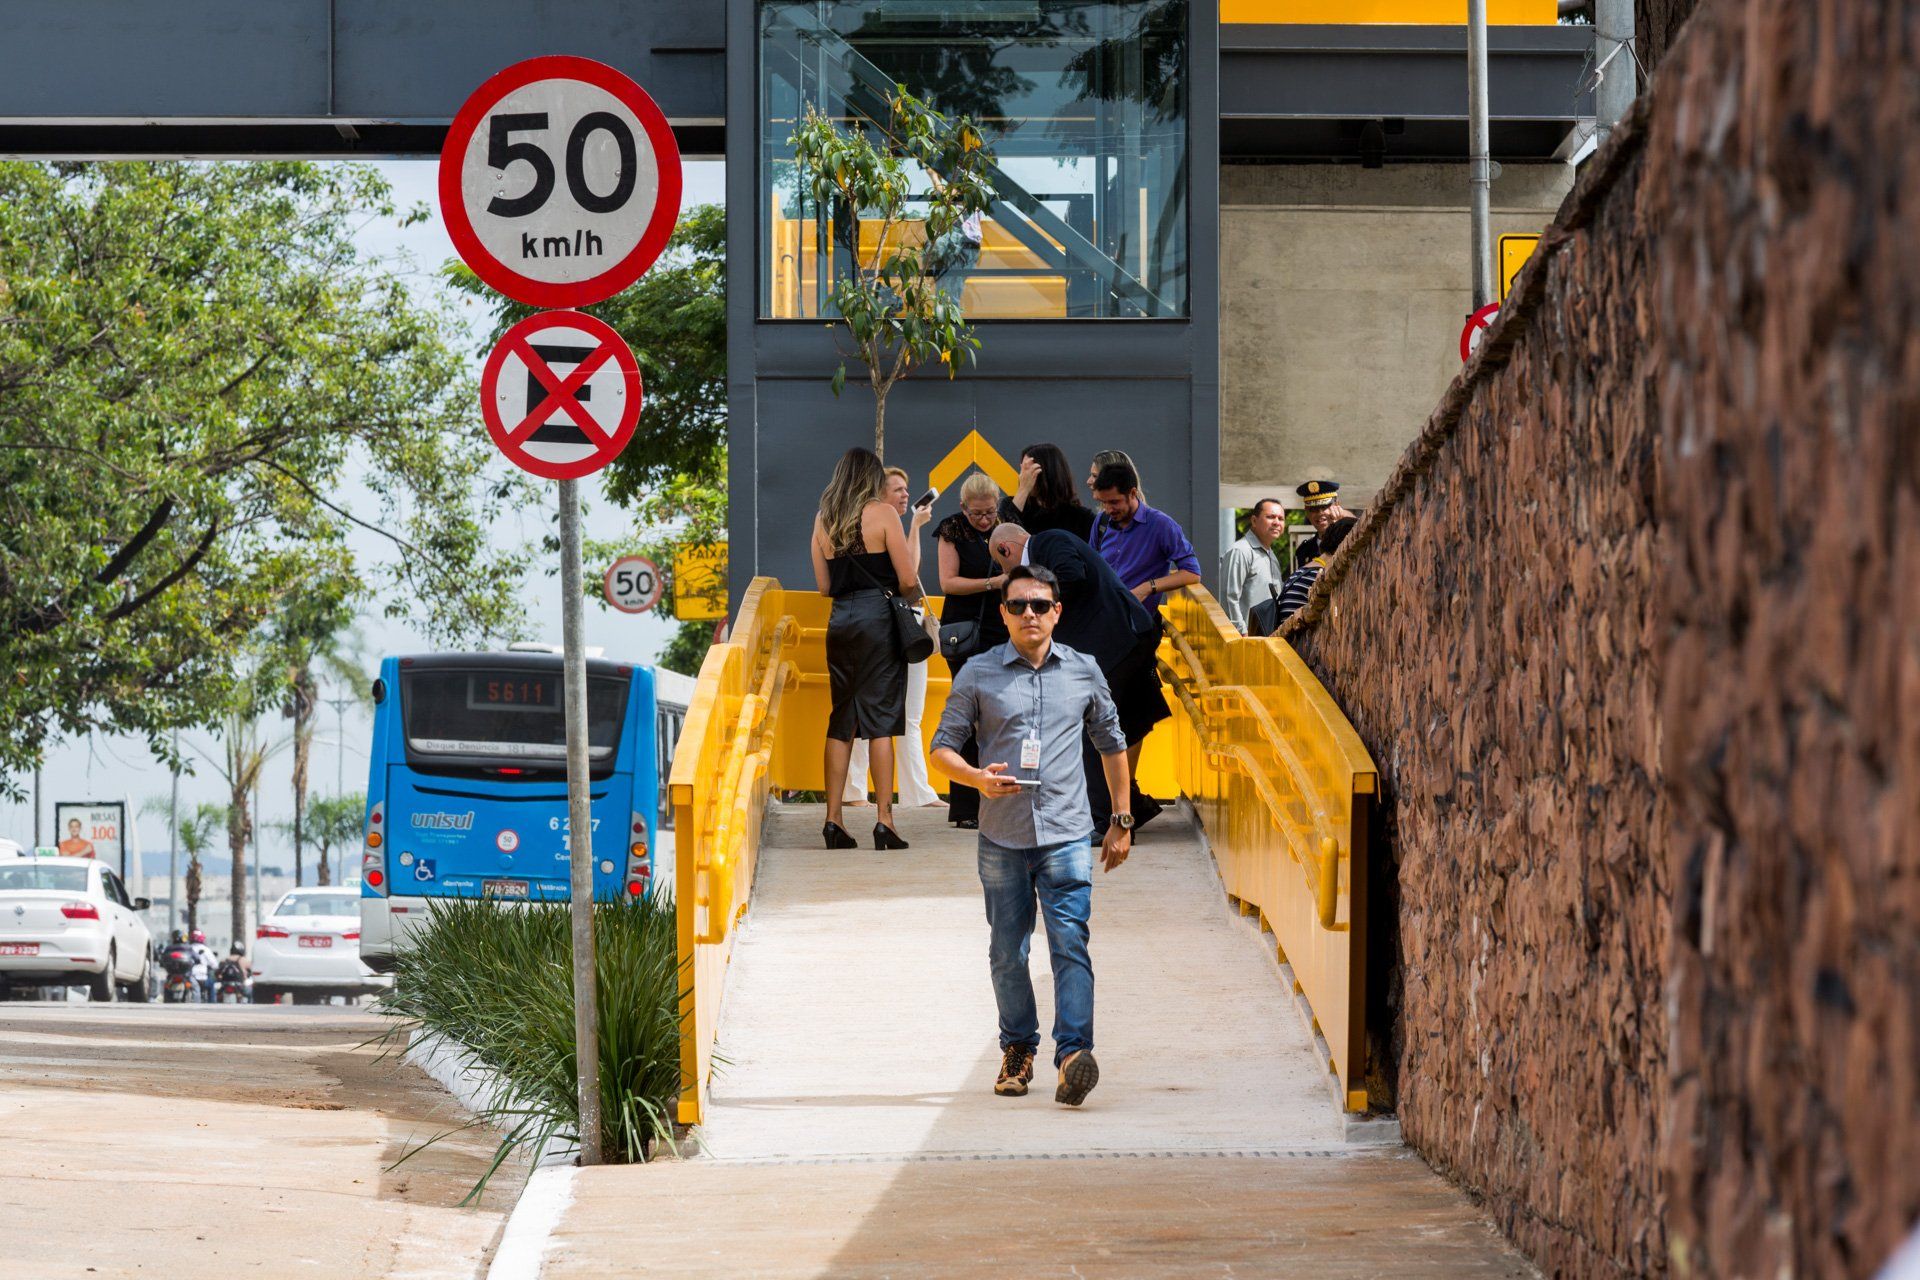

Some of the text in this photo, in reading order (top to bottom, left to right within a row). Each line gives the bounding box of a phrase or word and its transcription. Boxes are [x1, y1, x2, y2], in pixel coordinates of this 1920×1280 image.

[486, 111, 638, 218] 50
[521, 229, 603, 259] km/h
[616, 571, 653, 596] 50
[488, 681, 543, 704] 5611
[411, 811, 475, 831] unisul
